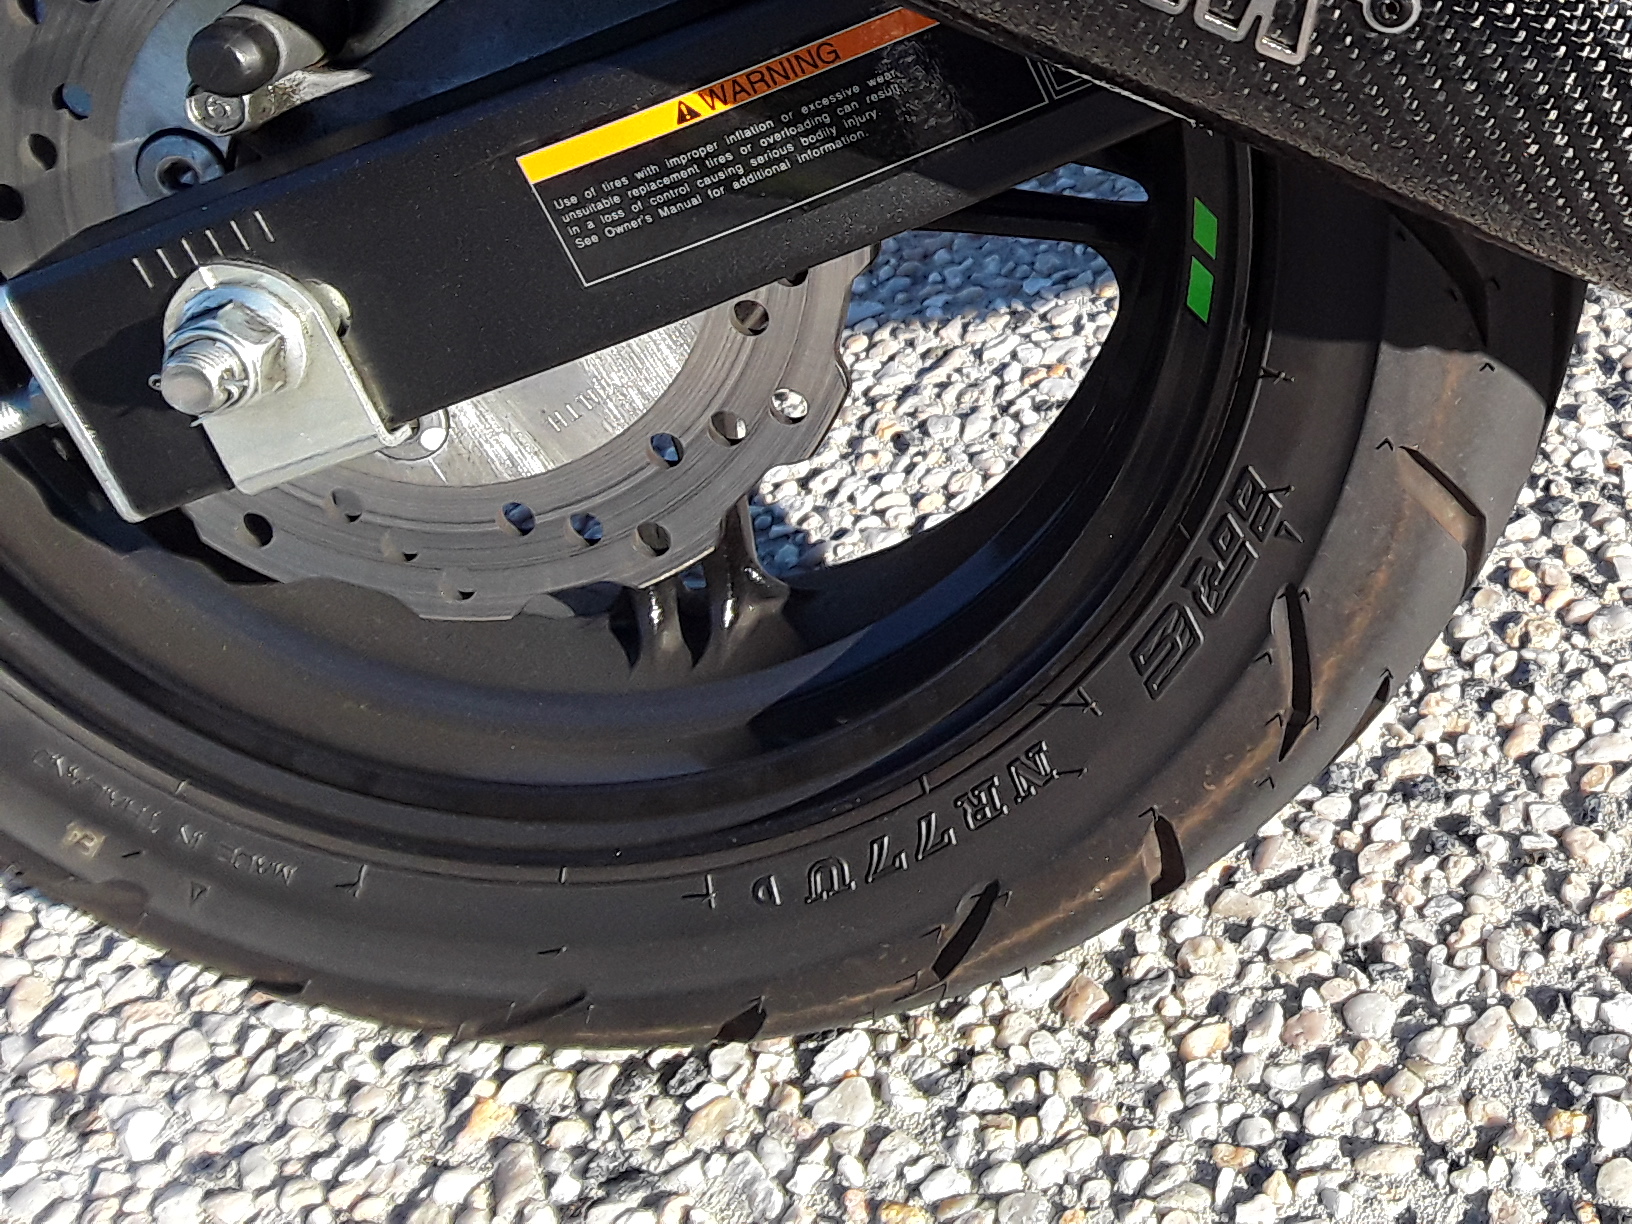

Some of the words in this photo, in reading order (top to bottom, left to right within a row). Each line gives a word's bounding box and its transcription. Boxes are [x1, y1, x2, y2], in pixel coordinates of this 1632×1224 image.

[699, 42, 841, 112] WARNING
[553, 194, 578, 210] Use
[584, 185, 597, 199] of
[602, 174, 630, 192] tires
[633, 163, 660, 181] with
[665, 140, 719, 172] improper
[725, 119, 774, 145] inflation
[780, 110, 794, 123] or
[800, 84, 860, 115] excessive
[561, 194, 622, 224] unsuitable
[627, 162, 700, 199] replacement
[705, 150, 734, 169] tires
[739, 141, 753, 155] or
[759, 112, 831, 147] overloading
[836, 100, 860, 116] can
[600, 208, 626, 224] loss
[631, 200, 644, 213] of
[649, 182, 692, 206] control
[696, 163, 745, 190] causing
[750, 142, 796, 167] serious
[800, 123, 838, 148] bodily
[574, 234, 600, 250] See
[604, 212, 654, 239] Owner's
[657, 193, 704, 219] Manual
[707, 185, 727, 200] for
[732, 158, 792, 191] additional
[804, 740, 1060, 904] NR77U
